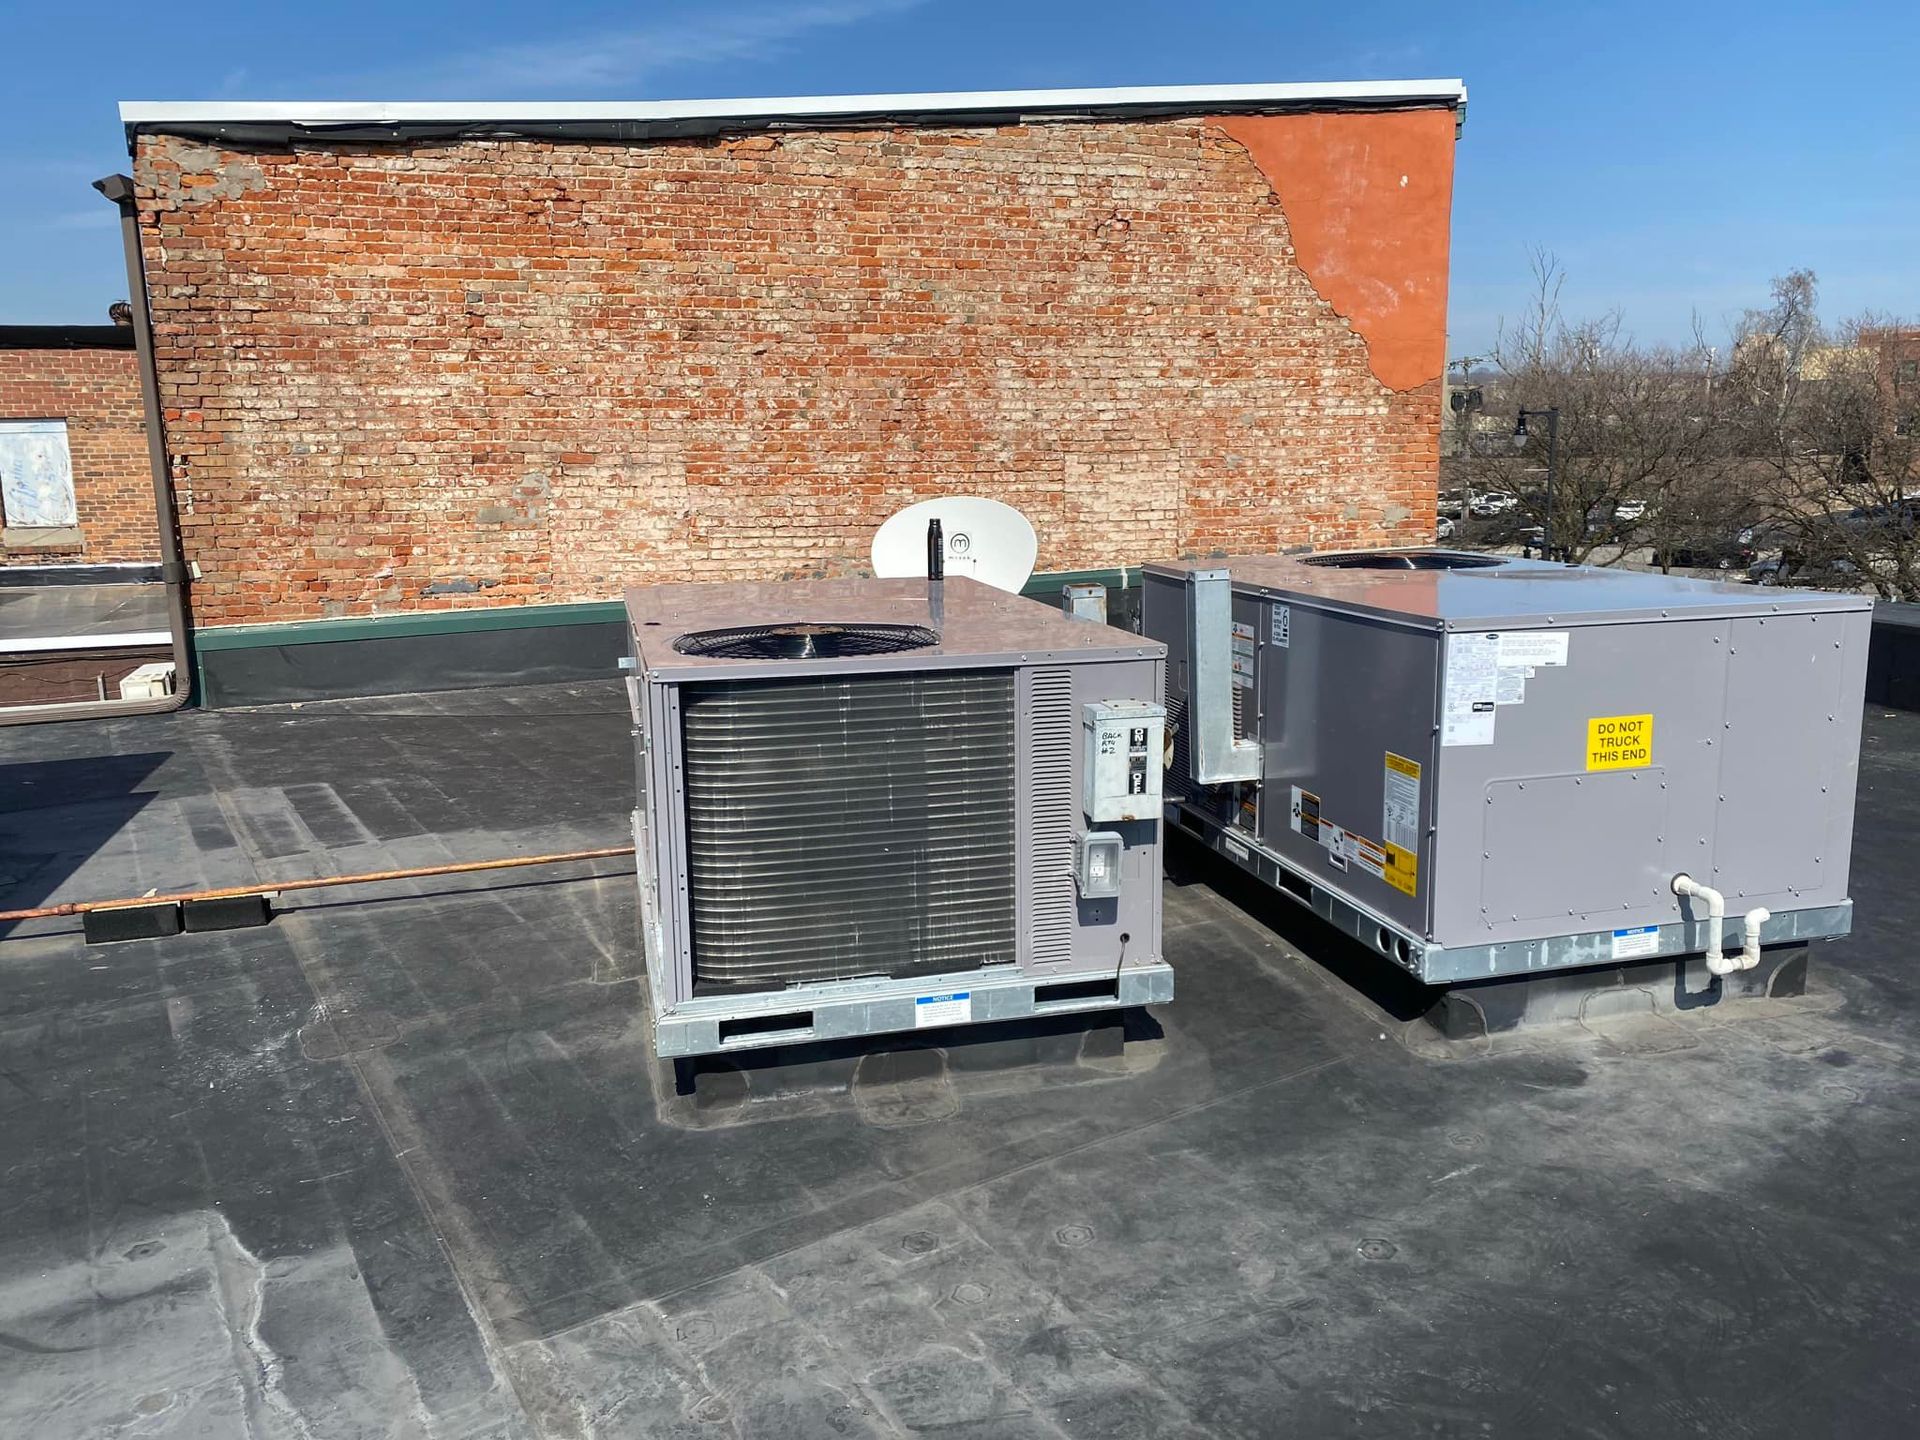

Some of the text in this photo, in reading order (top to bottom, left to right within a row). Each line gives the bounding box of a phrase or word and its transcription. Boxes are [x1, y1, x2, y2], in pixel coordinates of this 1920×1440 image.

[1598, 721, 1644, 734] DO NOT
[1101, 732, 1122, 740] BACK
[1134, 728, 1144, 742] ON
[1600, 735, 1640, 748] TRUCK
[1101, 747, 1116, 755] #2
[1592, 748, 1647, 763] THIS END
[1133, 773, 1142, 795] OFF
[932, 995, 953, 1003] NOTICE
